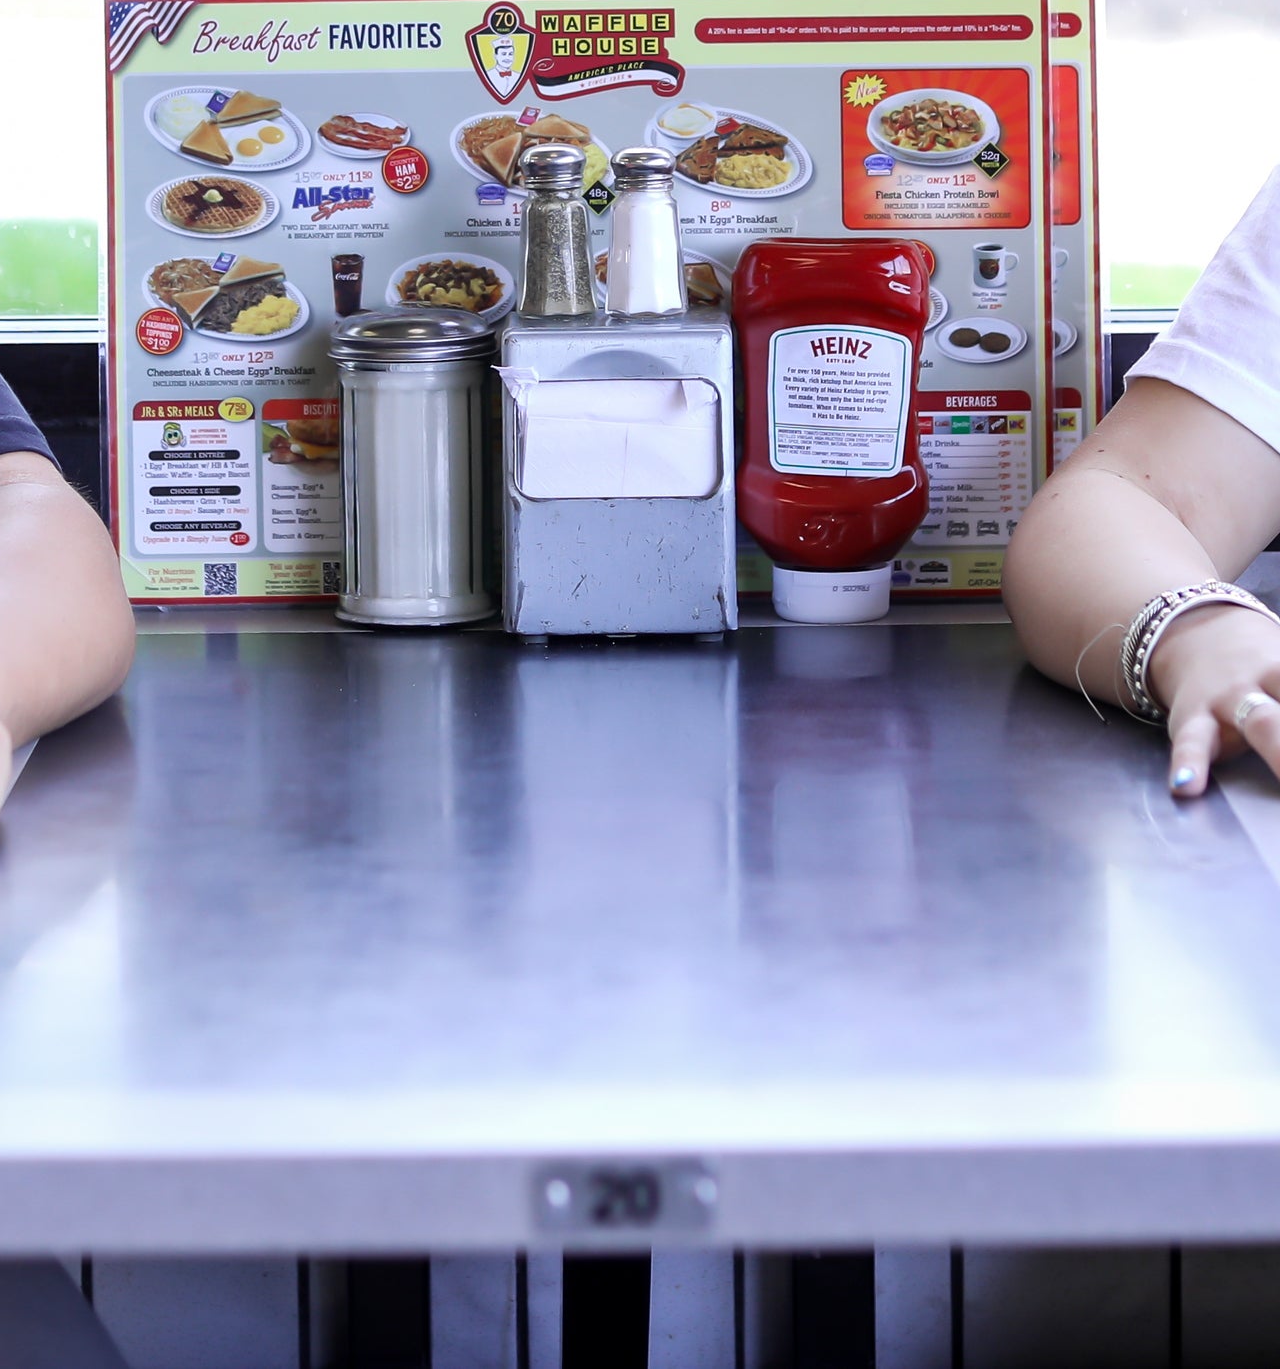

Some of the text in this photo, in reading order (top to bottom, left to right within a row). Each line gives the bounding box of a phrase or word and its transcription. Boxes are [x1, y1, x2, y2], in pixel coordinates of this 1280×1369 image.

[495, 12, 515, 27] 70
[542, 14, 667, 31] WAFFLE
[193, 20, 441, 63] Breakfast FAVORITES
[554, 39, 656, 54] HOUSE
[617, 61, 645, 72] PLACE
[981, 151, 1000, 162] 52g
[395, 163, 416, 177] HAM
[589, 188, 607, 199] 48g
[875, 190, 1000, 199] Fiesta Chicken Protein Bowl
[467, 219, 502, 228] Chicken
[505, 219, 511, 227] &
[736, 215, 778, 224] Breakfast
[810, 336, 872, 359] HEINZ
[146, 368, 201, 378] Cheesesteak
[204, 368, 210, 376] &
[213, 368, 245, 377] Cheese
[274, 367, 316, 375] Breakfast
[946, 396, 997, 407] BEVERAGES
[141, 406, 214, 418] JRs & SRs MEALS
[303, 404, 338, 415] BISCUIT
